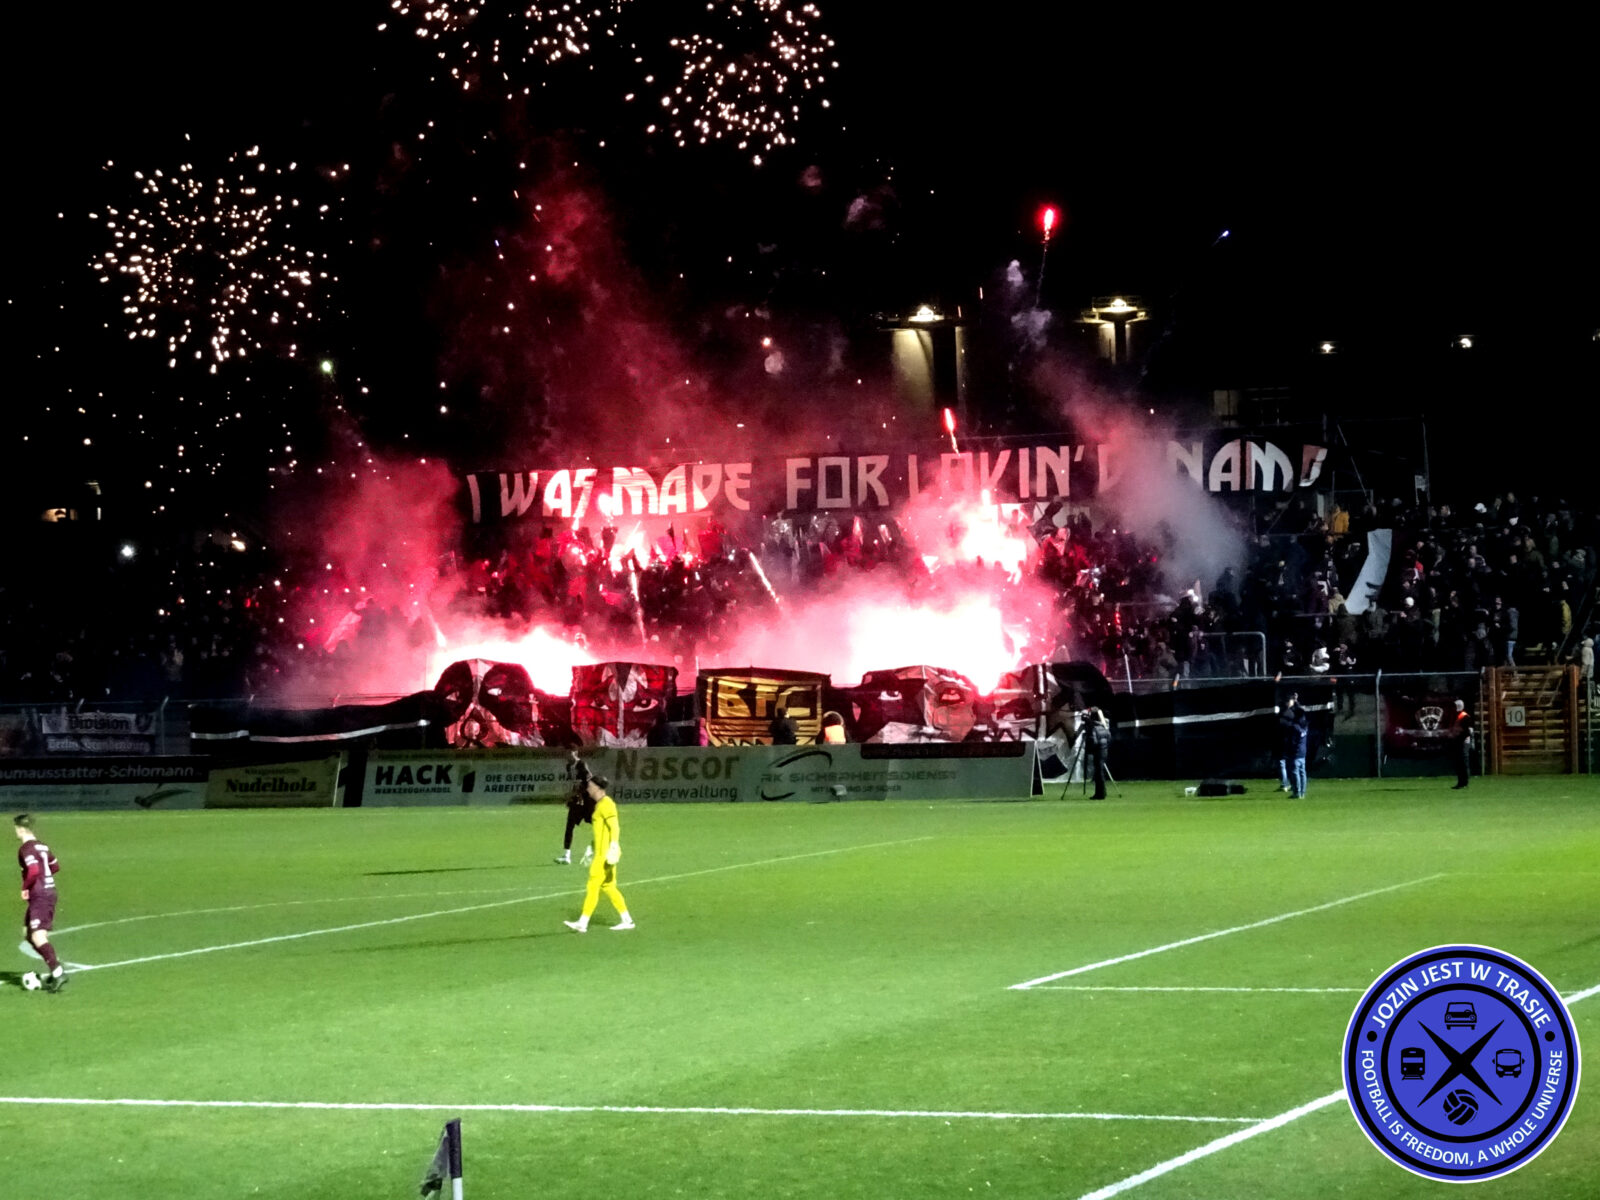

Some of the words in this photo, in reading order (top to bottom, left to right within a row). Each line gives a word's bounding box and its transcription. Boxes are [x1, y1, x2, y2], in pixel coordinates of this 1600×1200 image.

[466, 473, 482, 524] I
[499, 468, 598, 518] WAS
[612, 463, 752, 516] MADE
[786, 455, 890, 510] FOR
[716, 679, 814, 718] BFC
[1507, 709, 1524, 723] 10
[614, 748, 740, 780] Nascor
[376, 764, 454, 786] HACK
[485, 774, 502, 782] DIE
[505, 773, 555, 782] GENAUSO
[225, 777, 317, 793] Nudelholz
[484, 784, 535, 793] ARBEITEN
[612, 784, 738, 802] Hausverwaltung
